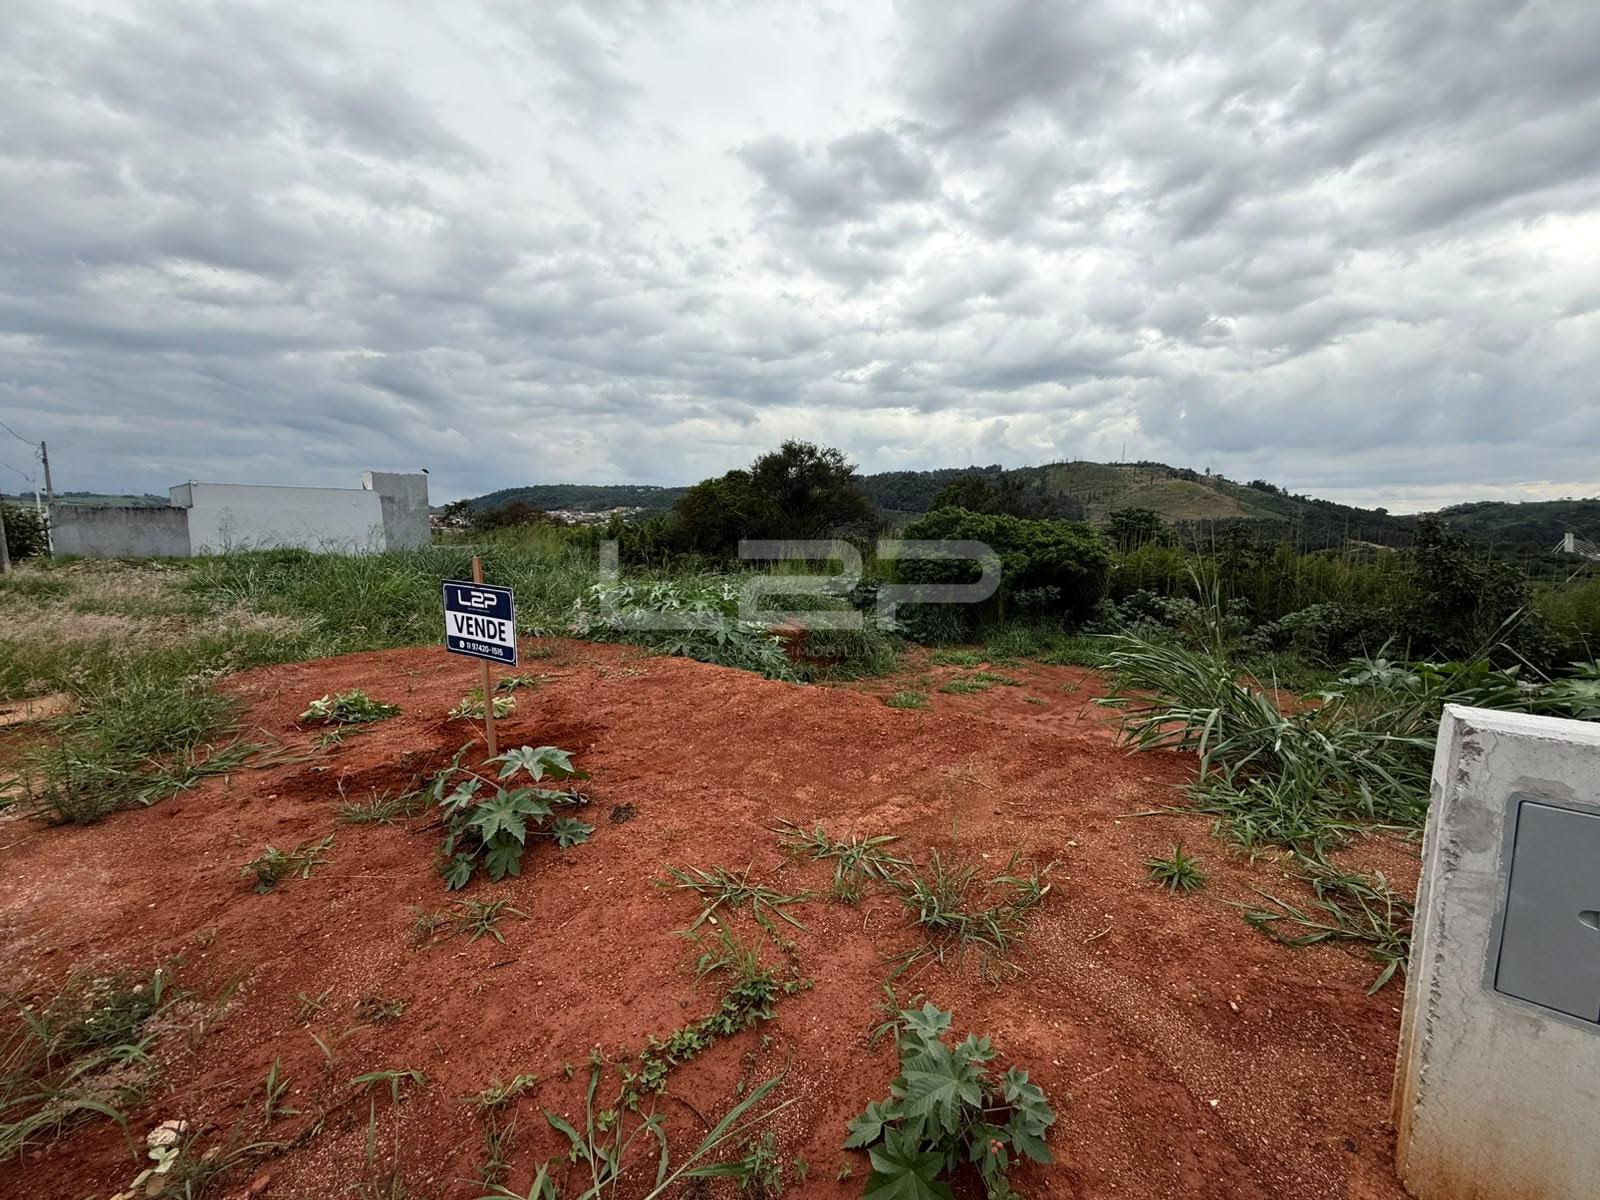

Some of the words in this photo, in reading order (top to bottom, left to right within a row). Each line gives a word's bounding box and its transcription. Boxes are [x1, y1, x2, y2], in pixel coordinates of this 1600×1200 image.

[457, 589, 497, 608] L2P
[453, 614, 506, 642] VENDE
[466, 641, 471, 649] 11
